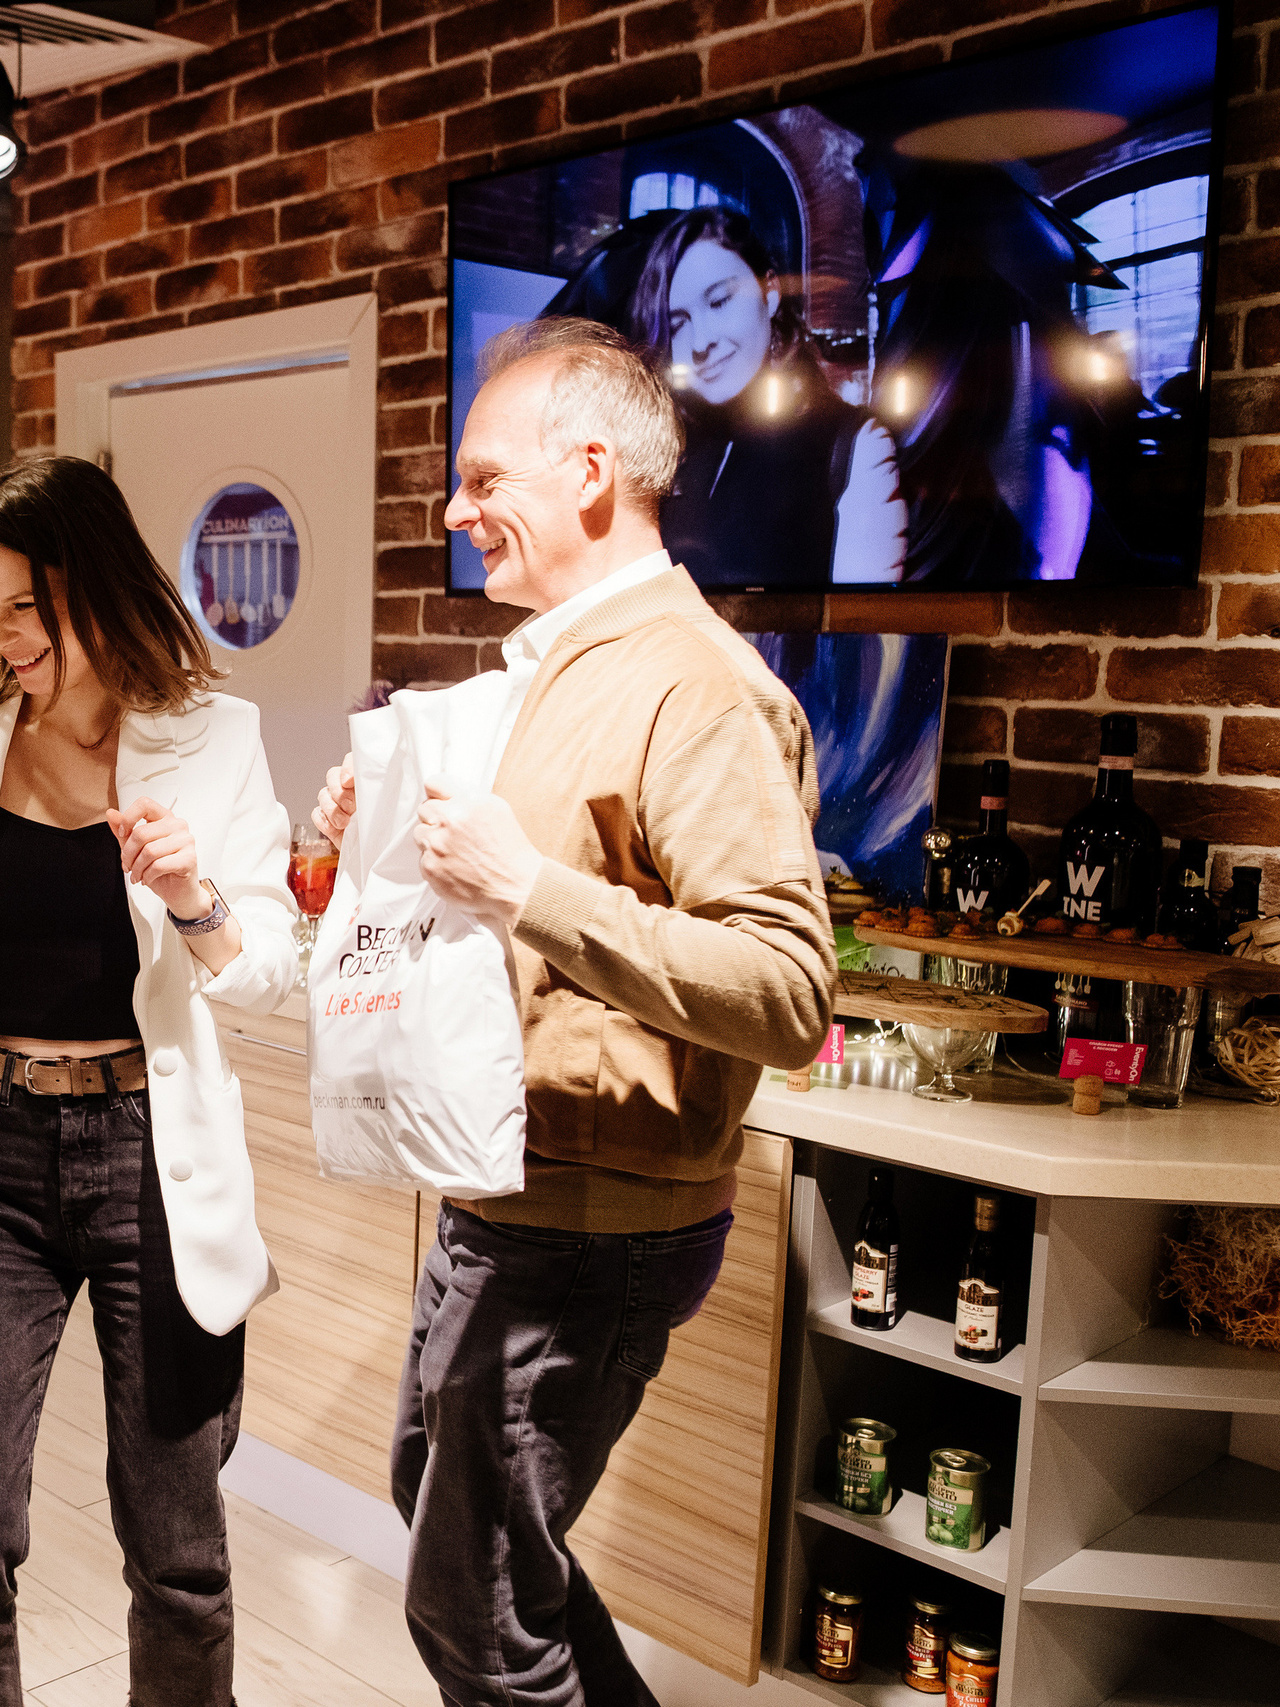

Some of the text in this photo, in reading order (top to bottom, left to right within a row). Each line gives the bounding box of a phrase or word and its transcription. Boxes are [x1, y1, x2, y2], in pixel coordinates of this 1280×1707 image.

[1066, 860, 1106, 897] W
[956, 887, 989, 913] W
[1128, 1046, 1145, 1082] EventyOn
[964, 1303, 984, 1313] GLAZE
